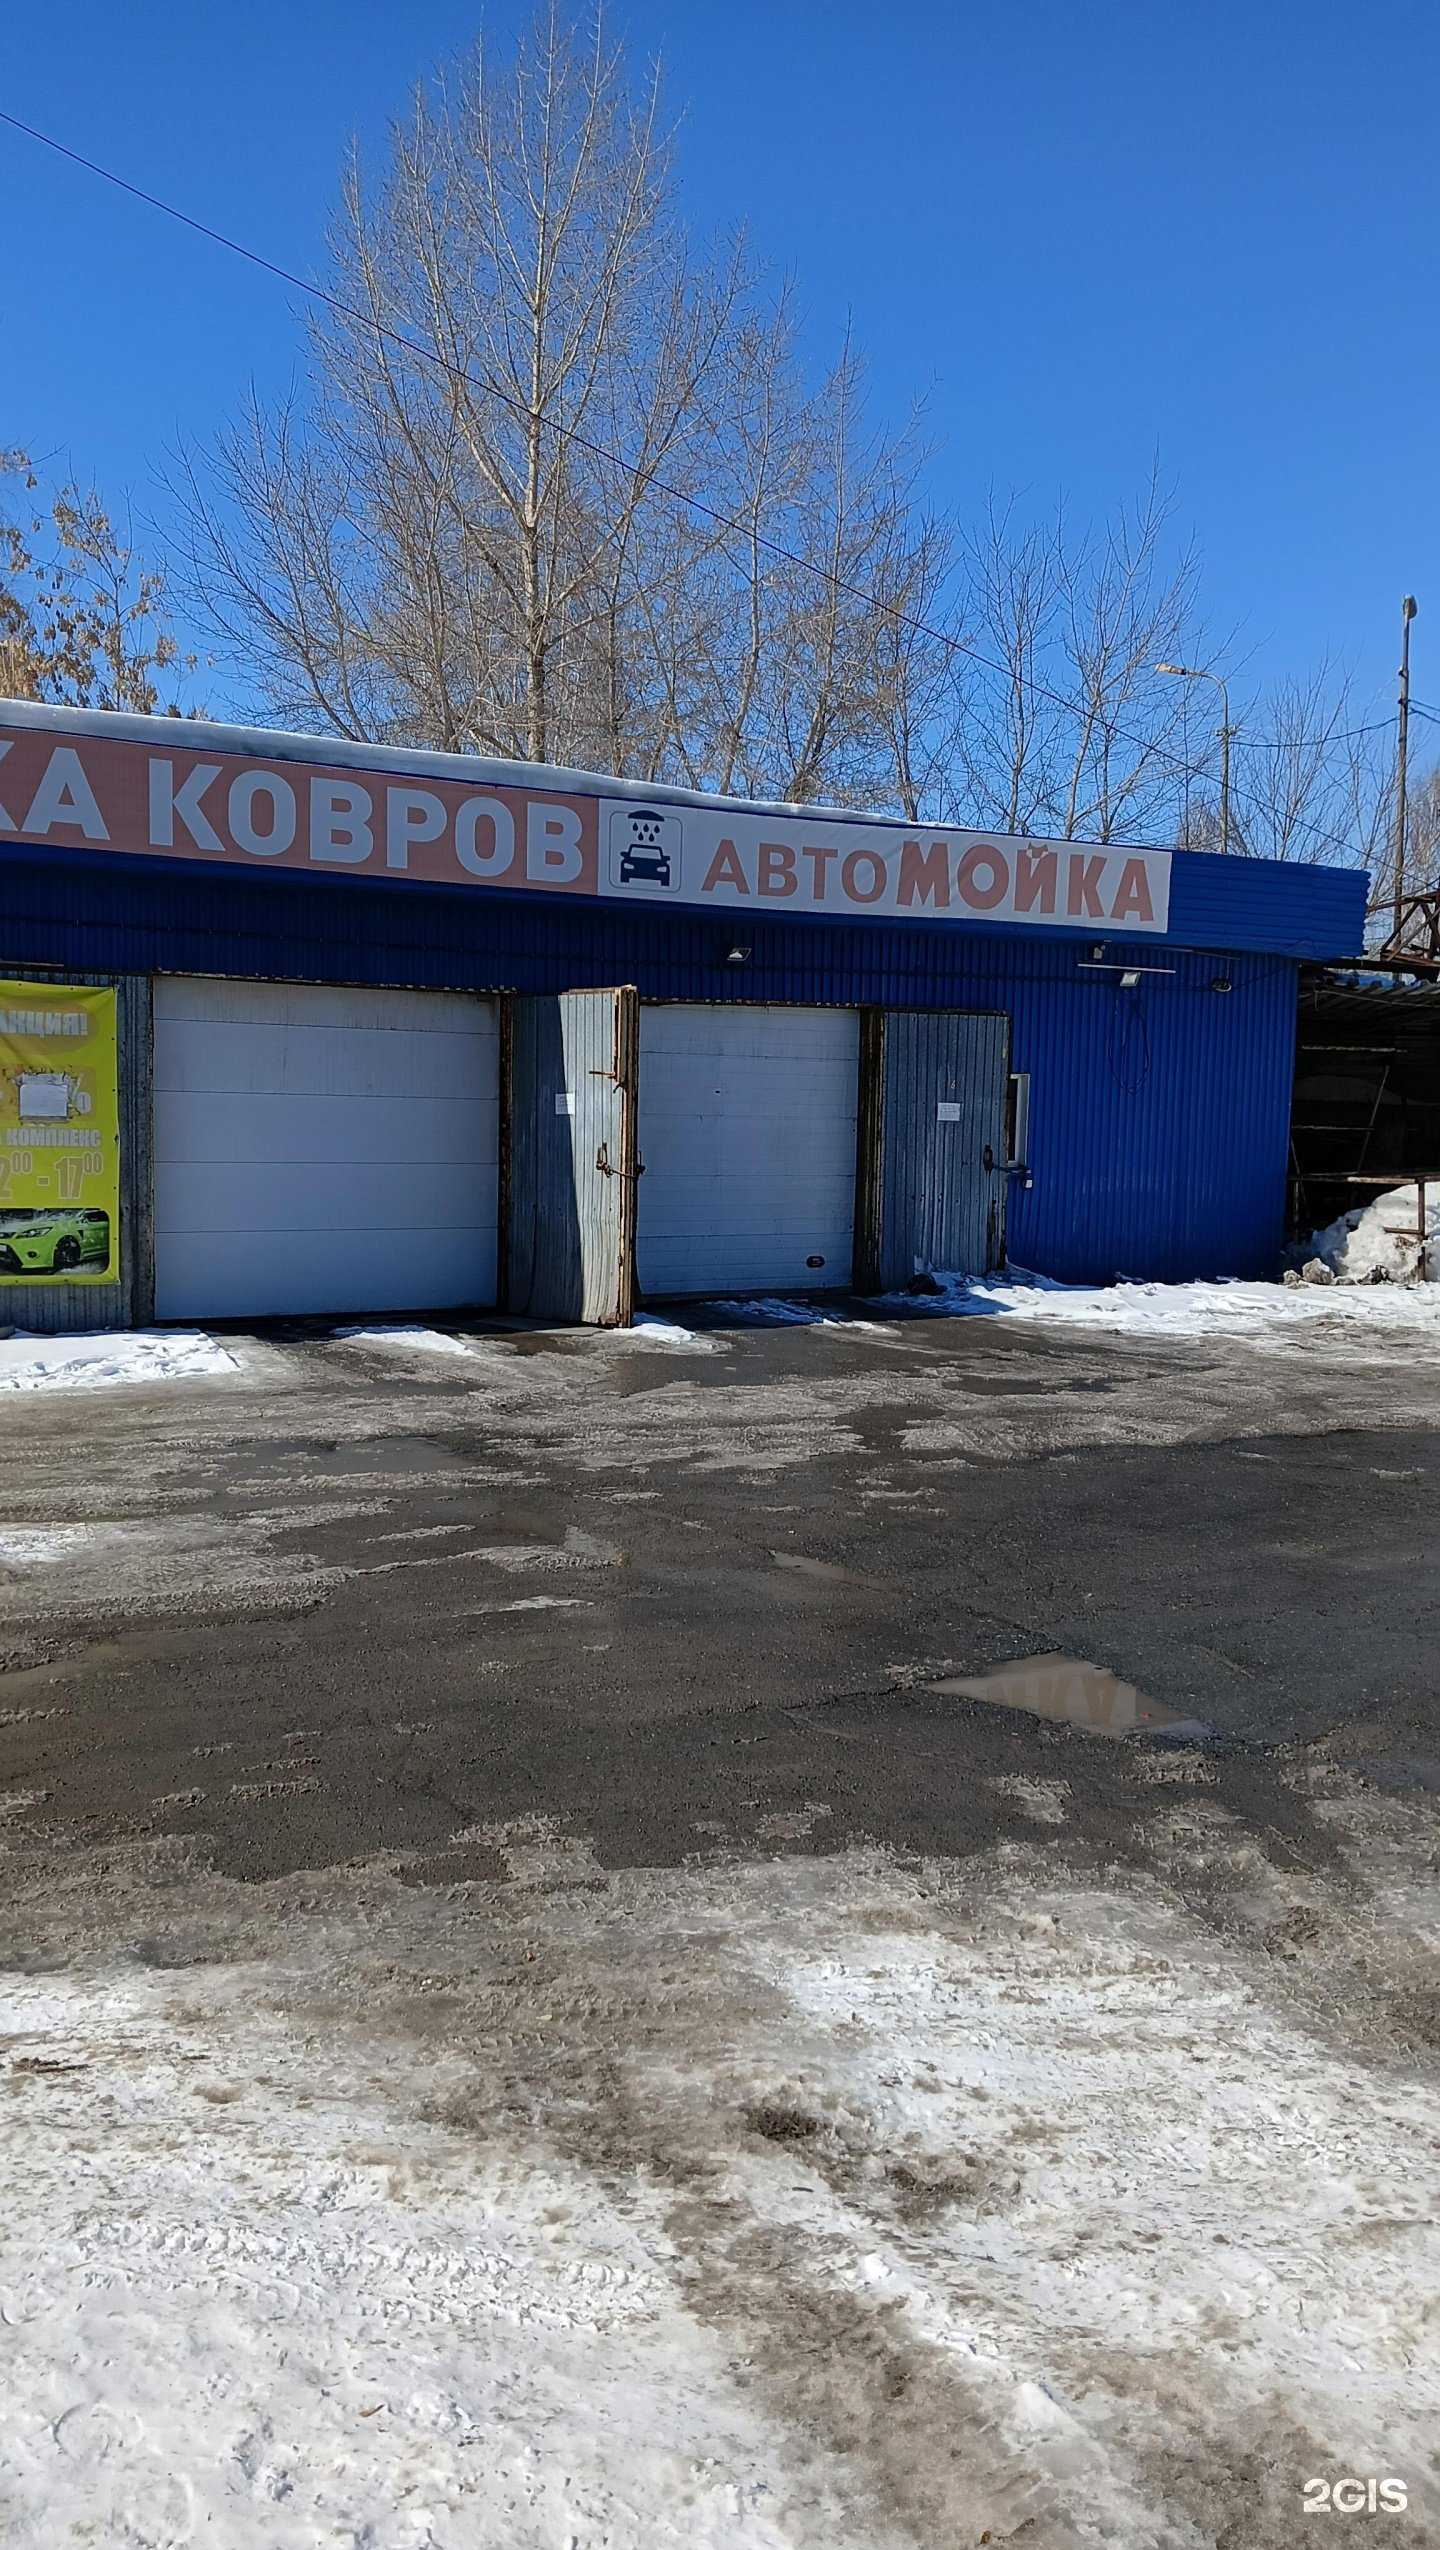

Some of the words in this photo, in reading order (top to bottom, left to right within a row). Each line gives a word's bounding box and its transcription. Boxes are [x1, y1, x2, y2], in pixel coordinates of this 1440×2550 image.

[0, 741, 110, 840] А
[149, 758, 583, 884] КОВРОВ
[701, 839, 1154, 922] АВТОМОЙКА
[6, 1127, 101, 1148] КОМПЛЕКС
